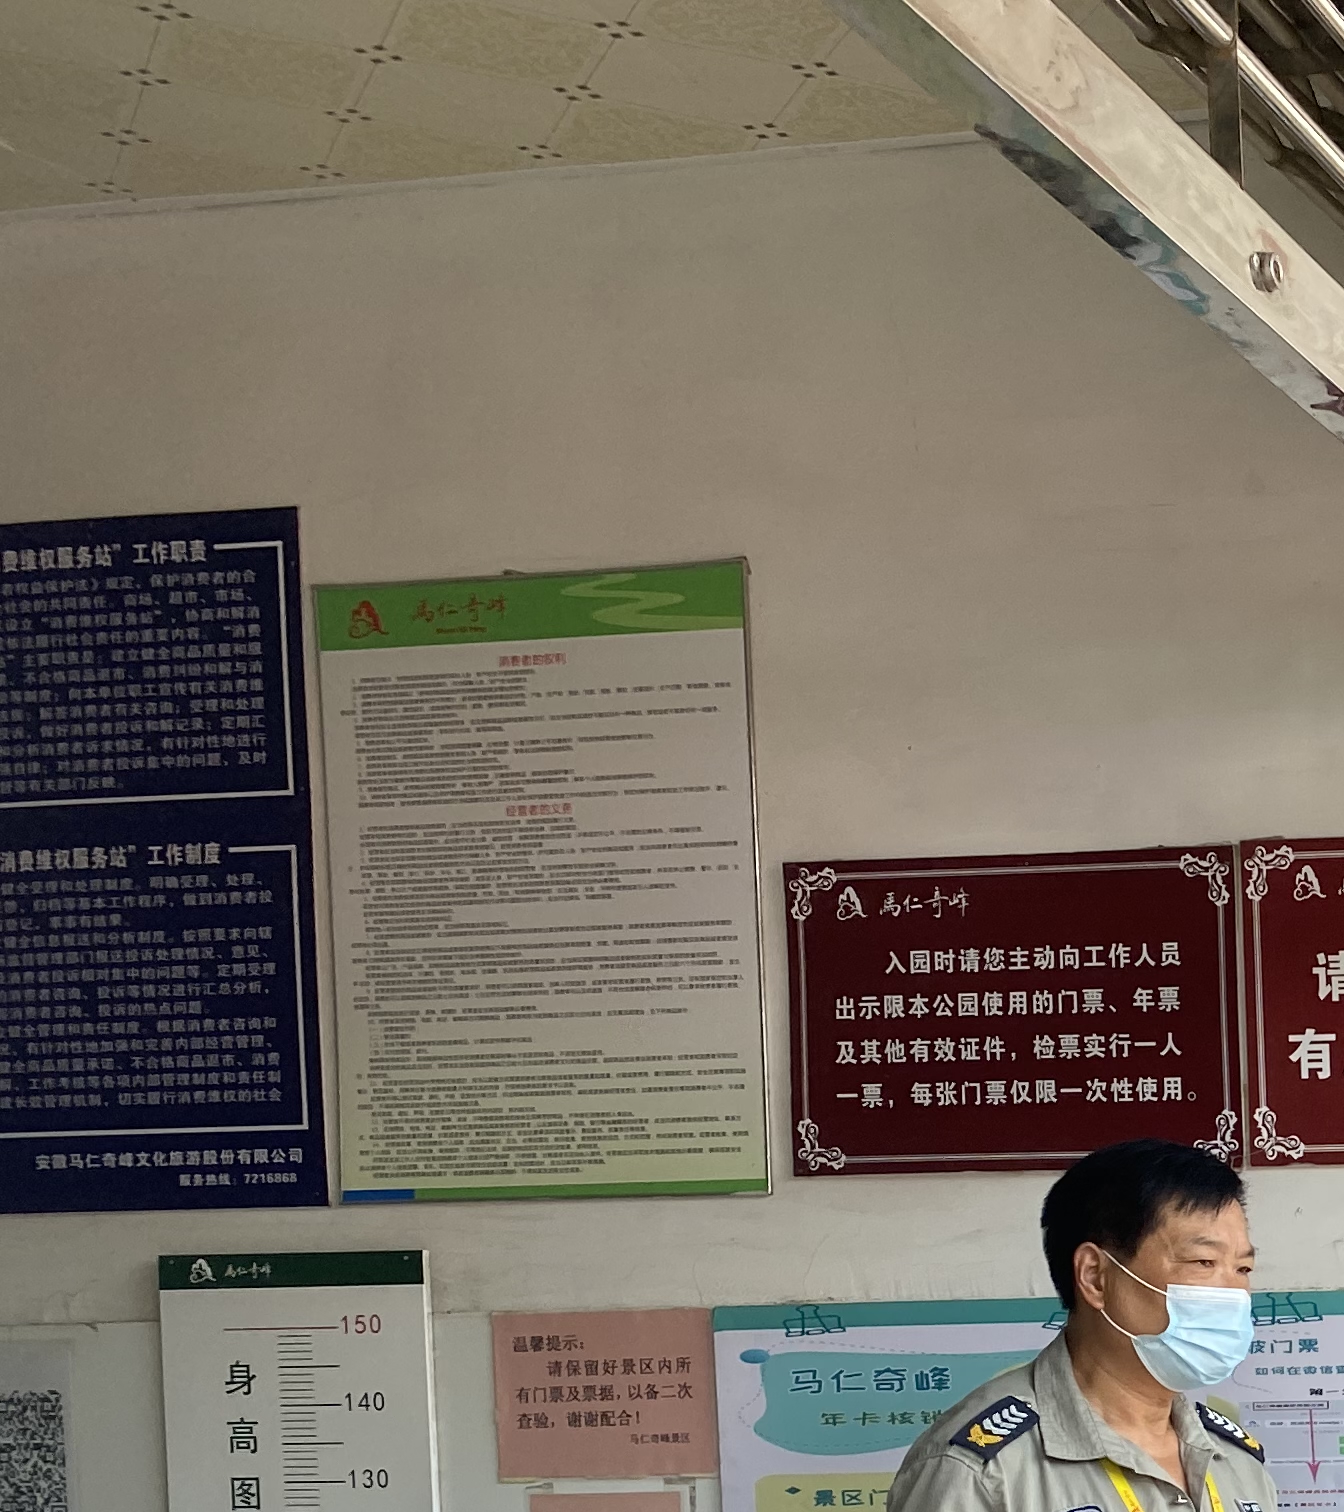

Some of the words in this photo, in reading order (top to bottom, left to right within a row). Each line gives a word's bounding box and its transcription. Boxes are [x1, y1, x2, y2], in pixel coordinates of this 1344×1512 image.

[885, 942, 1182, 975] 入园时请您主动向工作人员
[835, 986, 1182, 1021] 出示限本公园使用的门票、年票
[835, 1032, 1183, 1065] 及其他有效证件，检票实行一人
[835, 1076, 1198, 1109] 一票，每张门票仅限一次性使用。
[35, 1147, 304, 1171] 安徽马仁奇峰文化旅游股份有限公司
[340, 1314, 381, 1334] 150
[512, 1335, 585, 1352] 温馨提示：
[547, 1356, 692, 1378] 请保留好景区内所
[788, 1367, 952, 1394] 马仁奇峰
[344, 1391, 385, 1412] 140
[516, 1382, 694, 1404] 有门票及票据，以备二次
[517, 1411, 641, 1430] 查验，谢谢配合！
[629, 1432, 690, 1445] 马仁奇峰景区
[348, 1469, 389, 1489] 130
